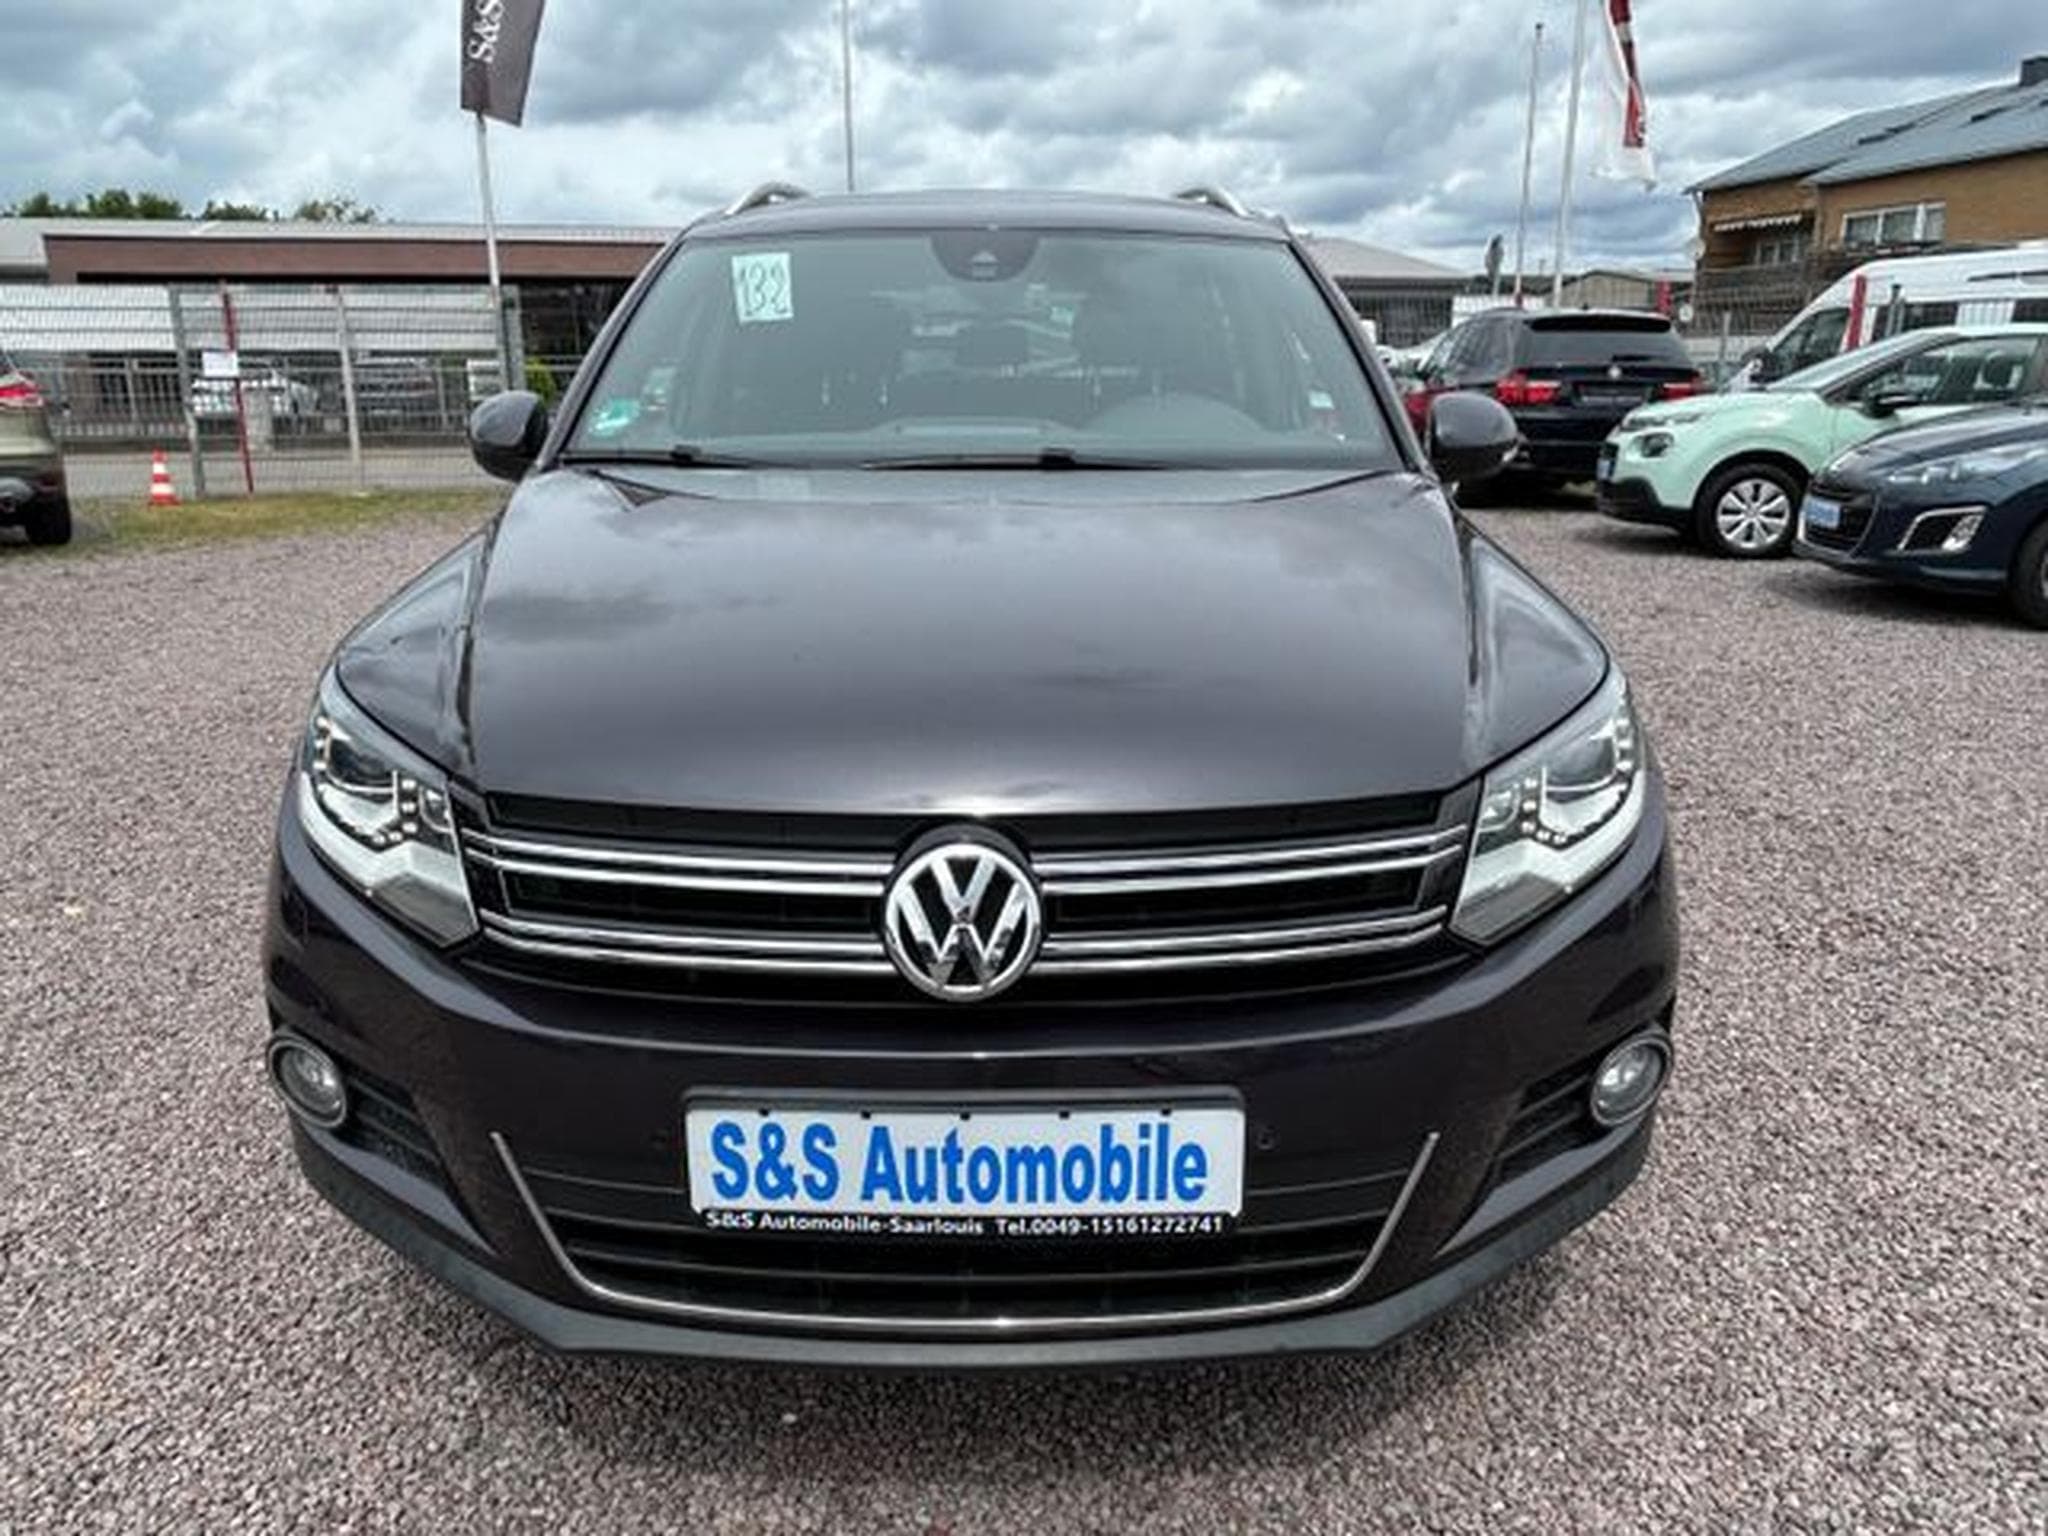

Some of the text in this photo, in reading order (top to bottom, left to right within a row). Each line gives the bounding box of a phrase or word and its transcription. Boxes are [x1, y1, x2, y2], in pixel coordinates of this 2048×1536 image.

[467, 0, 505, 63] S&S
[739, 260, 788, 317] 132
[711, 1120, 1208, 1204] S&S Automobile
[705, 1210, 755, 1230] S&S
[758, 1212, 984, 1235] Automobile-Saarlouis
